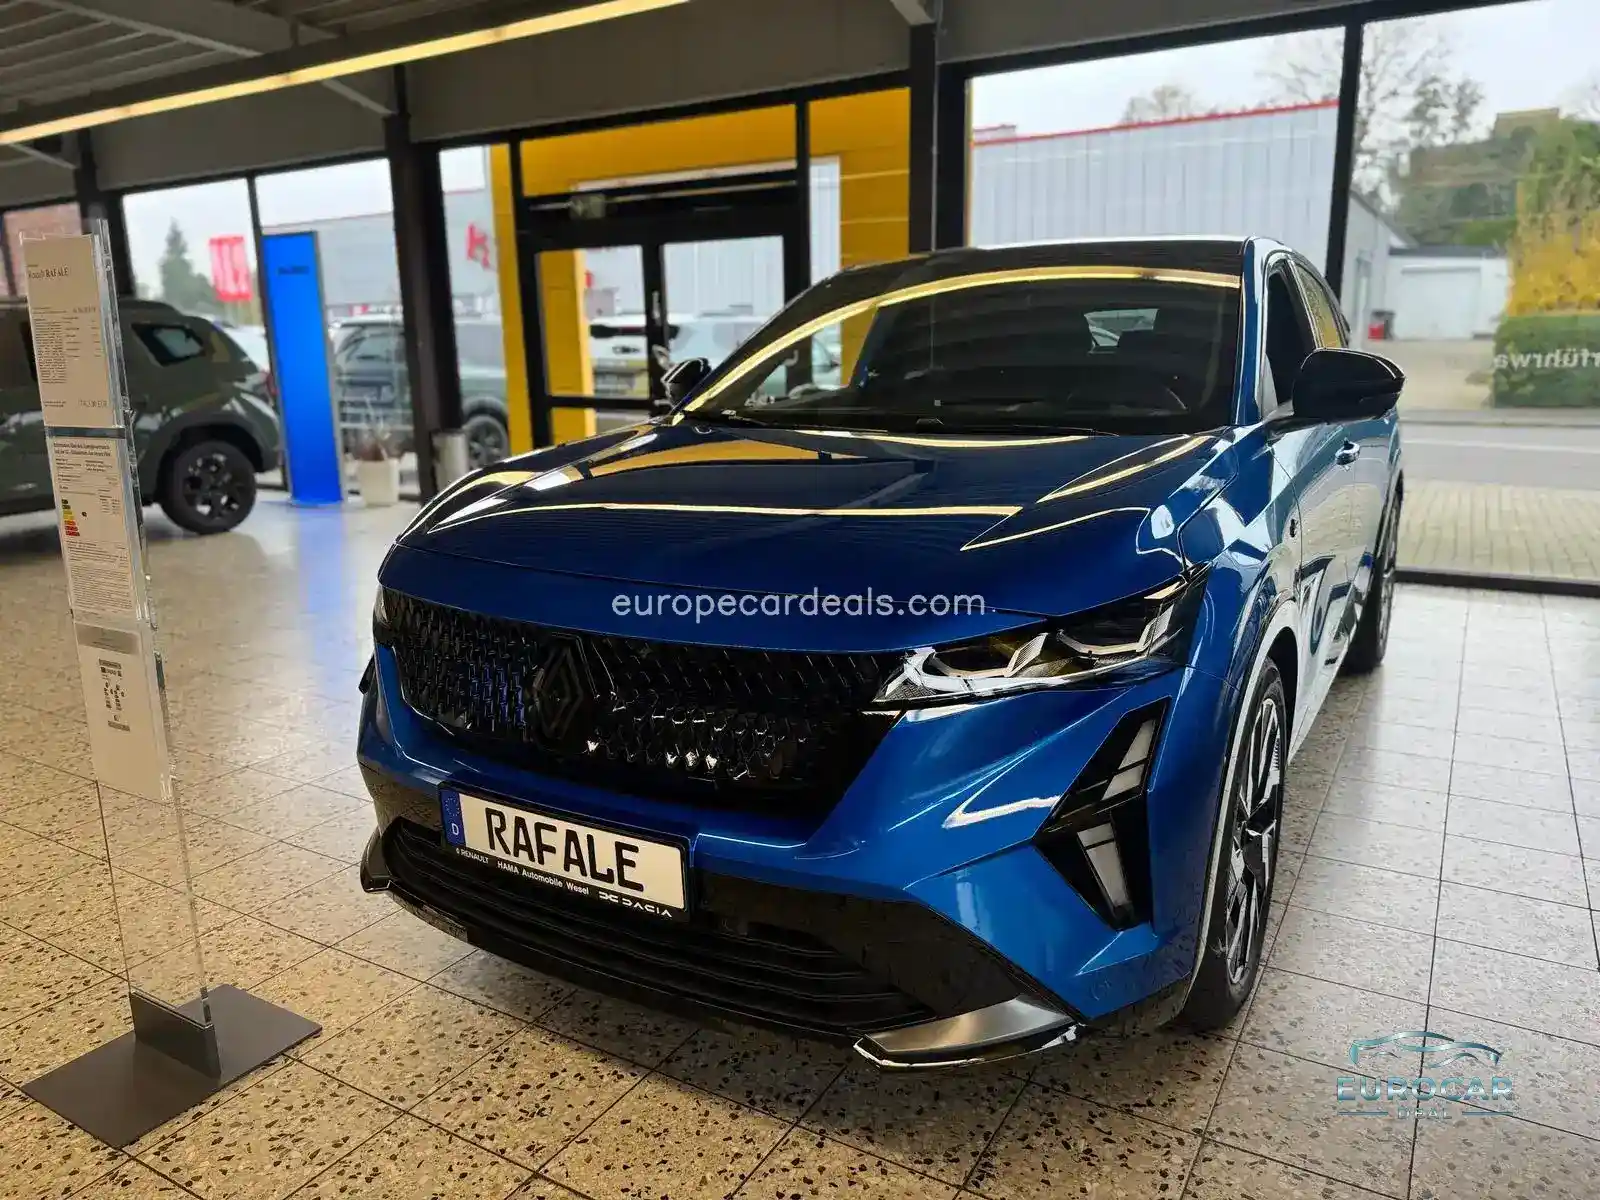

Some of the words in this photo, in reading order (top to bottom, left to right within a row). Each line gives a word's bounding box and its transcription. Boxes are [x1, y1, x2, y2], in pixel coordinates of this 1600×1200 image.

[450, 822, 460, 836] D
[484, 806, 644, 892] RAFALE
[460, 849, 489, 865] RENAULT
[497, 860, 520, 875] HAMA
[521, 870, 563, 888] Automobile
[565, 881, 590, 896] Wesel
[621, 897, 673, 918] DACIA
